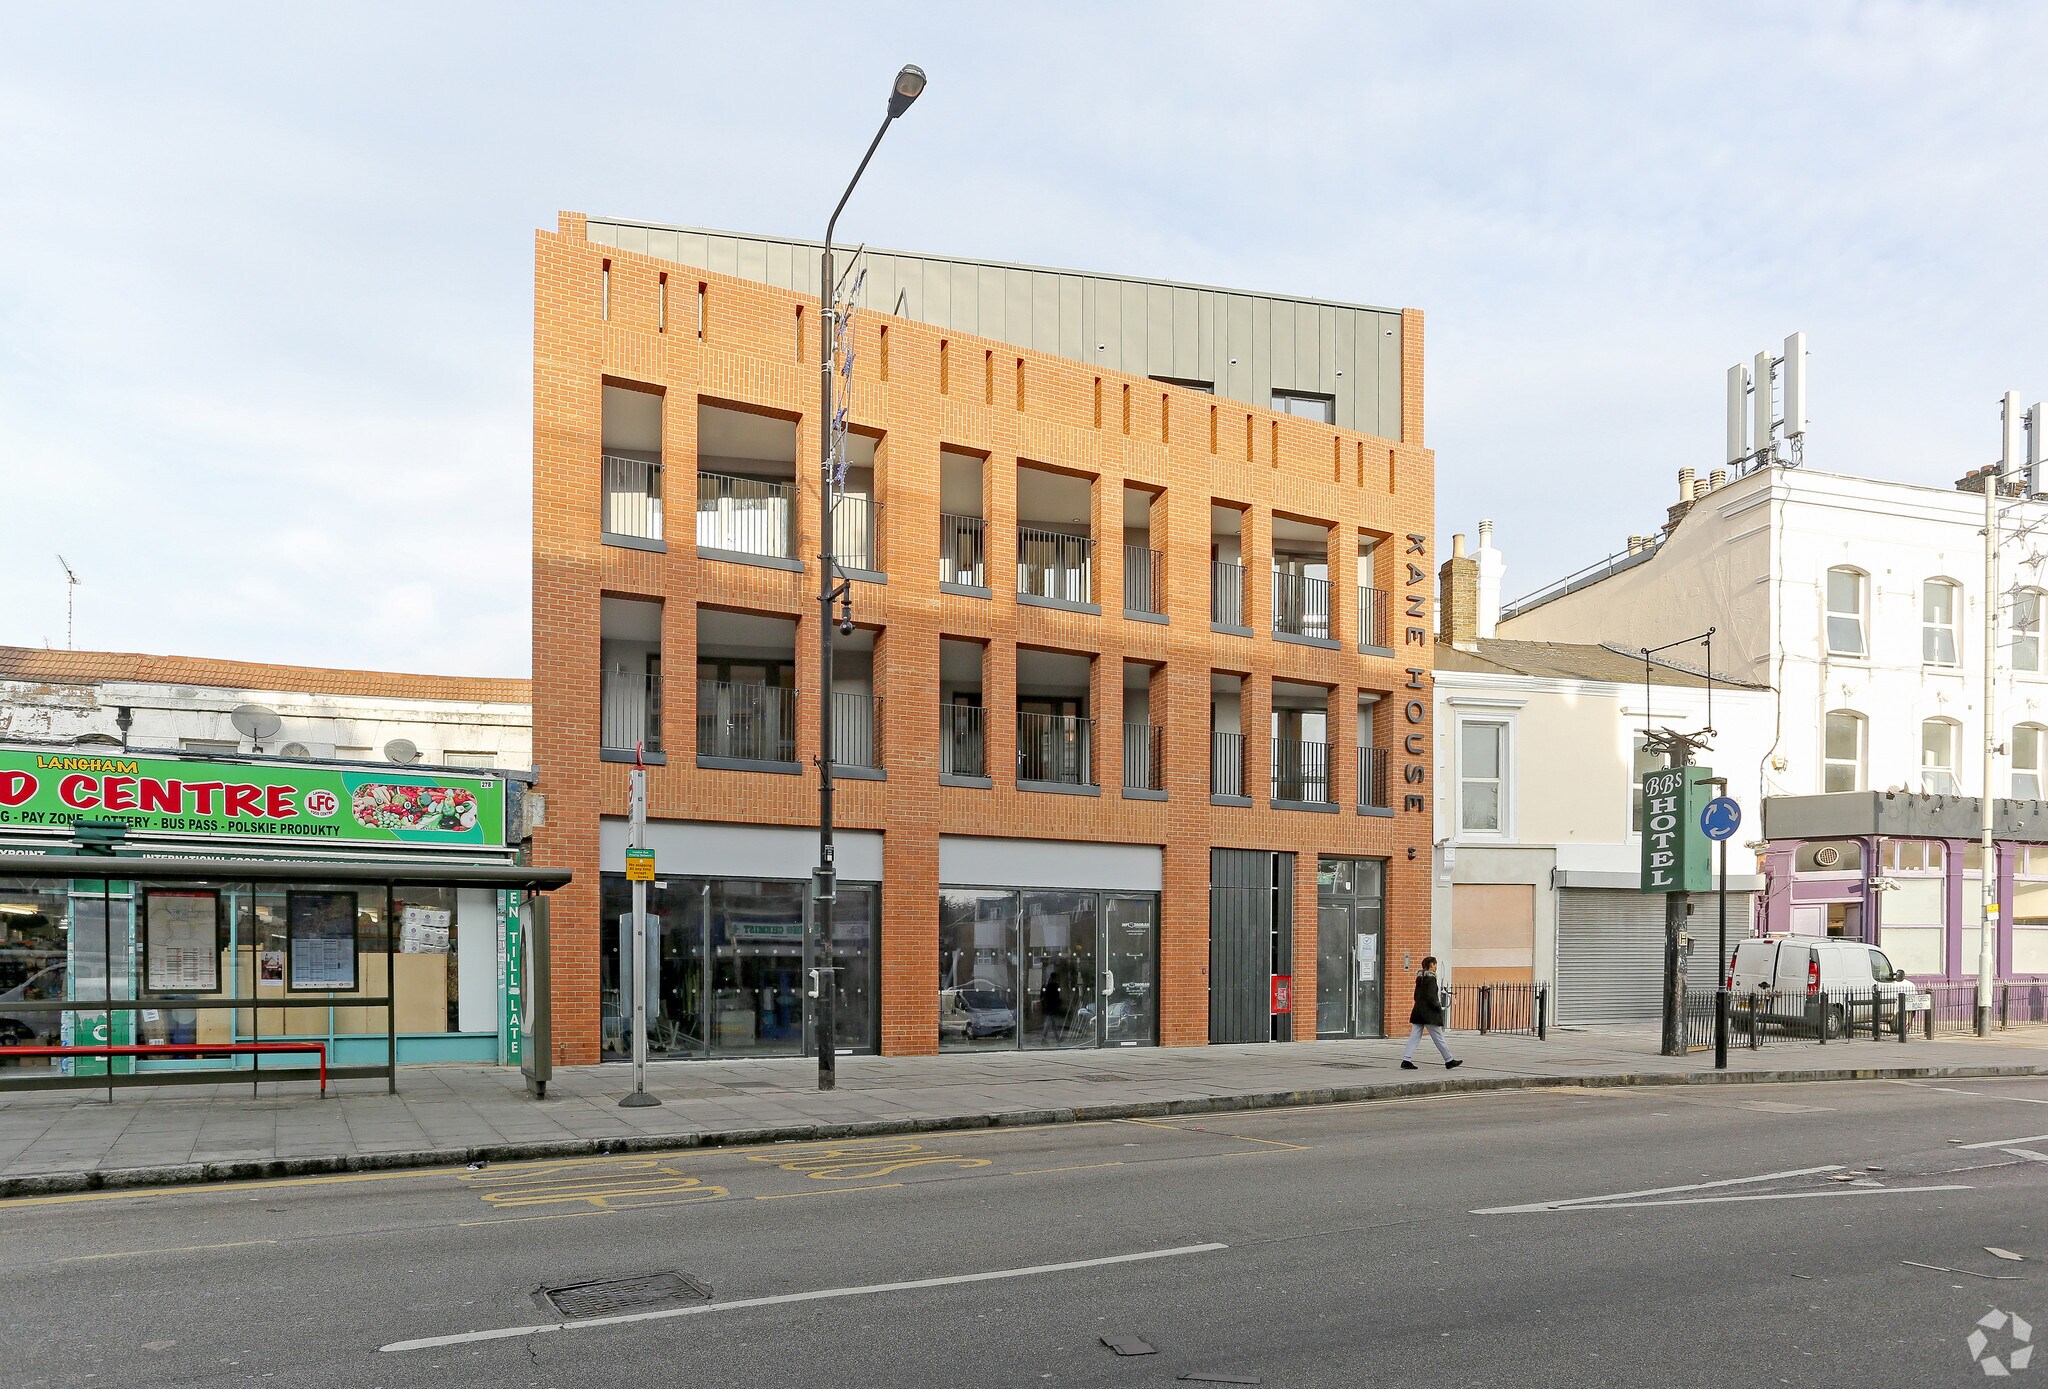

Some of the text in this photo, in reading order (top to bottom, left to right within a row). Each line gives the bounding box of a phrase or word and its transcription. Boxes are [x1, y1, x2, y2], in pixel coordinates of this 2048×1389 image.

[1405, 533, 1426, 813] KANE HOUSE
[36, 755, 139, 775] LANGHAM
[60, 775, 299, 819] CENTRE
[308, 795, 335, 811] LFC
[22, 811, 45, 824] PAY
[49, 812, 84, 825] ZONE
[161, 818, 185, 830] BUS
[188, 819, 218, 831] PASS
[228, 821, 277, 834] POLSKIE
[280, 823, 340, 836] PRODUKTY
[1650, 796, 1677, 886] HOTEL
[1680, 933, 1687, 945] H
[508, 932, 519, 1053] TILL LATE
